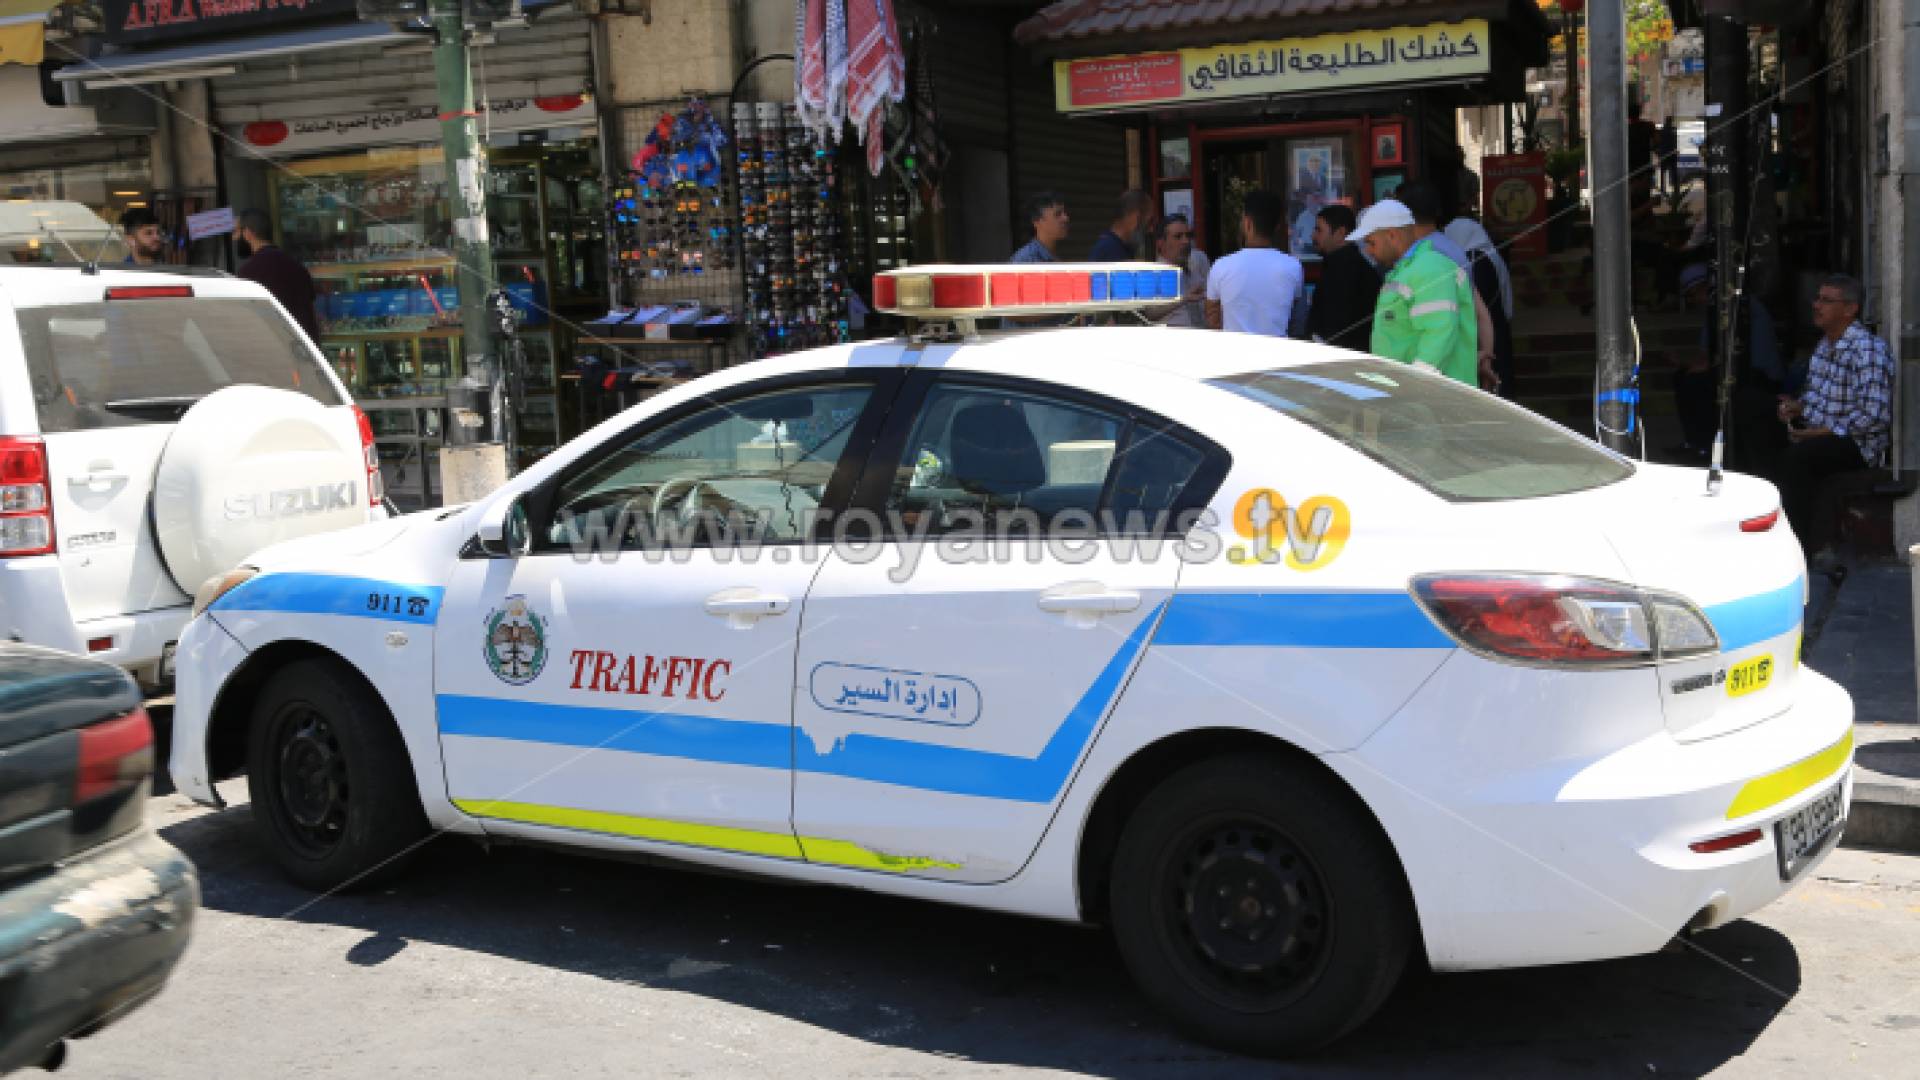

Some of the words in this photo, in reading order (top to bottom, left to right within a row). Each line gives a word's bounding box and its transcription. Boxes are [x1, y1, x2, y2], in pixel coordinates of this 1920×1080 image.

[1288, 37, 1397, 75] الطليعة
[1399, 32, 1480, 61] كشك
[1188, 48, 1285, 90] الثقافي
[224, 480, 357, 521] SUZUKI
[367, 592, 401, 614] 911
[569, 650, 732, 702] TRAFFIC
[834, 677, 900, 706] السير
[904, 679, 957, 719] إدارة
